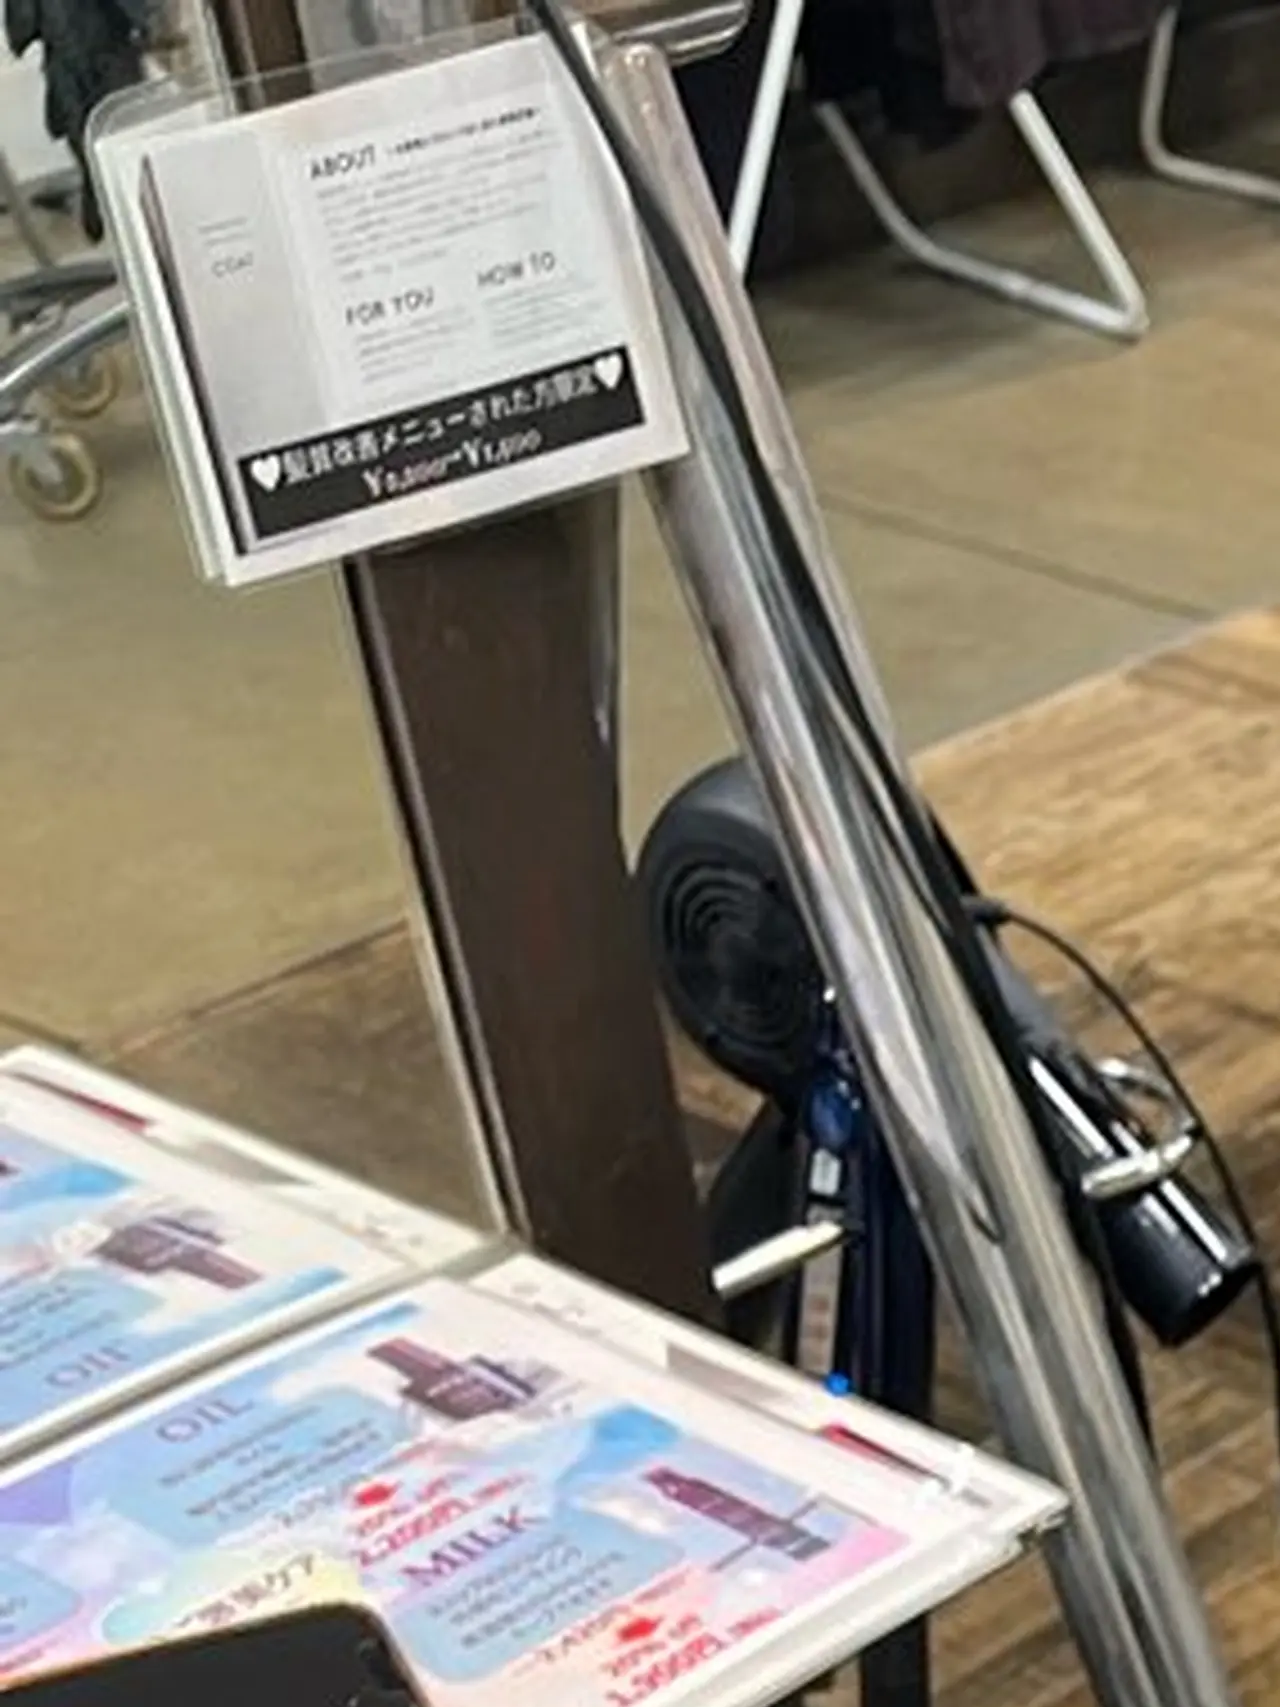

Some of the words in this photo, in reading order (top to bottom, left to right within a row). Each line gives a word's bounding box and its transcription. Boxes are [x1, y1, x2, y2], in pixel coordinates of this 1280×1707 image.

[310, 144, 376, 180] ABOUT
[478, 261, 524, 287] HOW
[530, 251, 556, 274] TO
[346, 300, 386, 326] FOR
[392, 287, 434, 314] YOU
[155, 1396, 255, 1443] OIL
[402, 1503, 550, 1588] MILK
